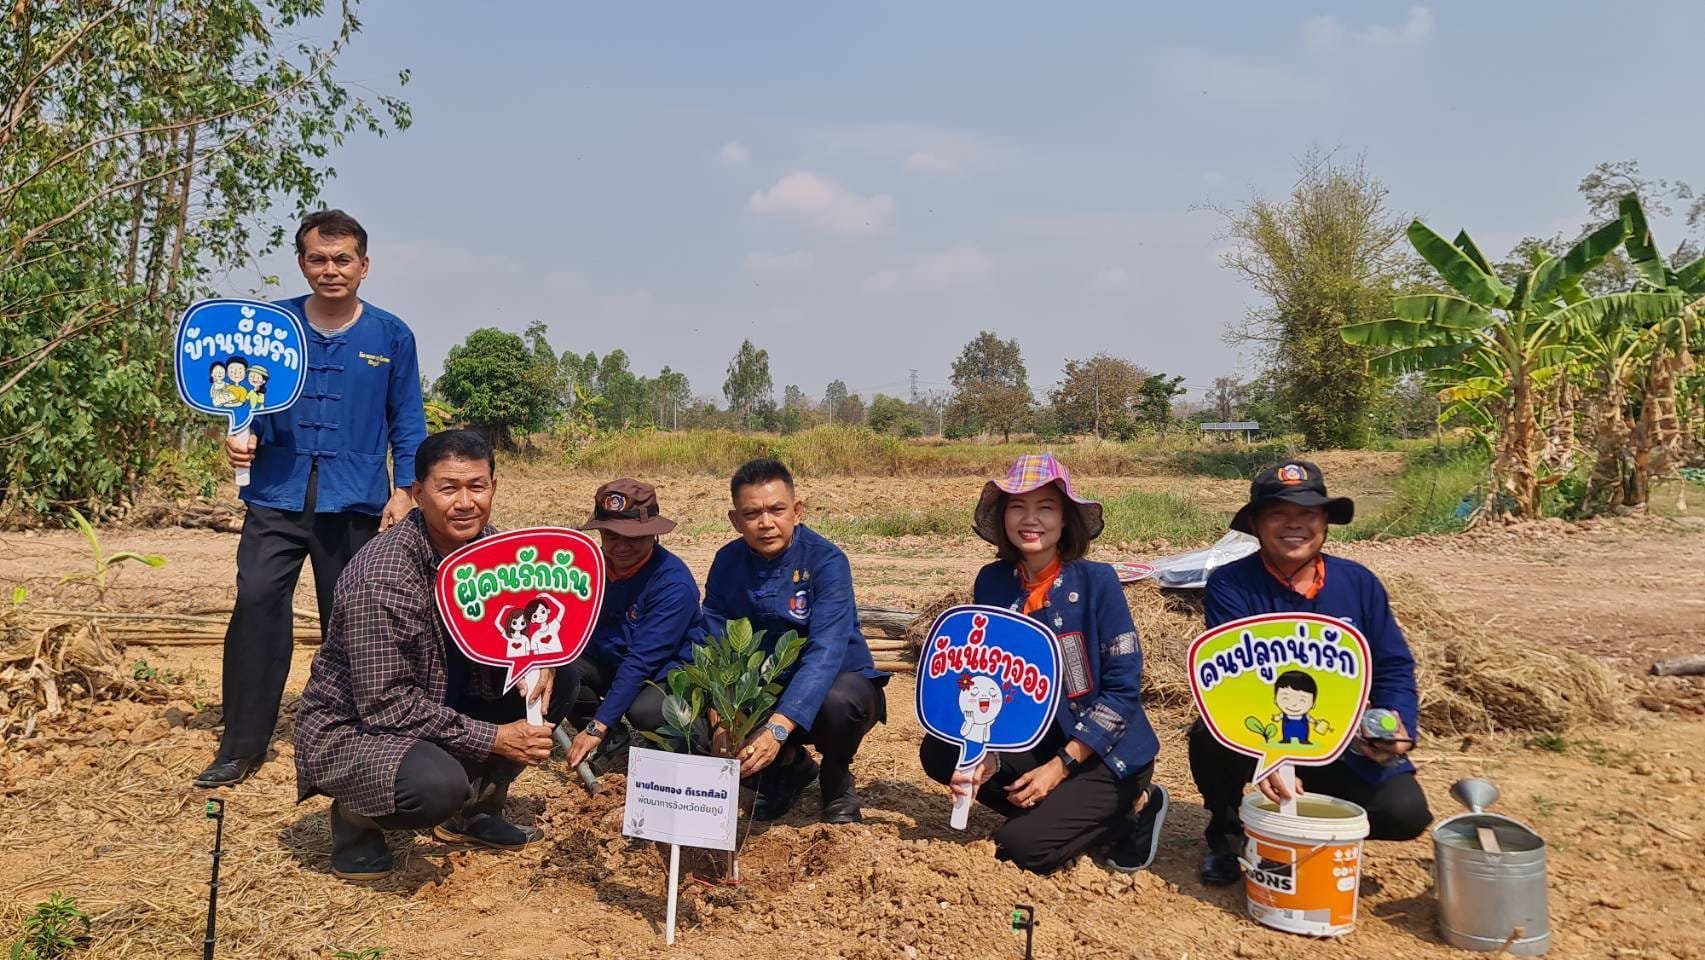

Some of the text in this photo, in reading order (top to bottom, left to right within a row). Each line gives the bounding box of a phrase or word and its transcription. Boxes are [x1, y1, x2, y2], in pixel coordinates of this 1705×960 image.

[184, 306, 298, 370] บ้านนี้มีรัก
[455, 547, 591, 619] ผู้คนรักกัน
[930, 615, 1049, 702] ต้นนี้เราจอง
[1199, 625, 1355, 688] คนปลูกน่ารัก
